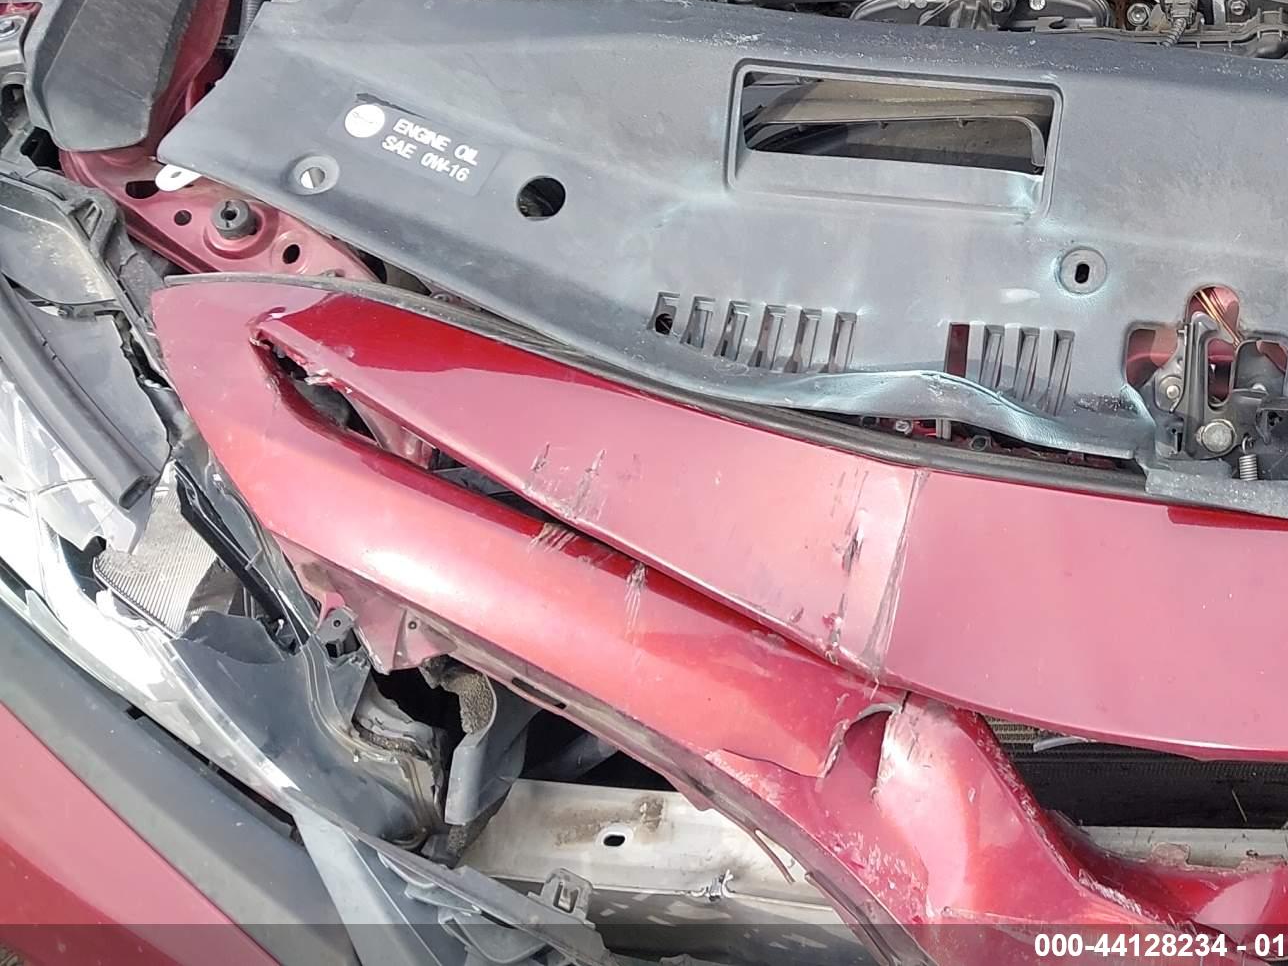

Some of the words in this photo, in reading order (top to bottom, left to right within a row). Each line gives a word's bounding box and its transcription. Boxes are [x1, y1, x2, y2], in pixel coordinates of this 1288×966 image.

[382, 135, 417, 159] SAE
[420, 152, 470, 182] 0W-16
[393, 118, 451, 152] ENGINE
[454, 144, 479, 166] OIL
